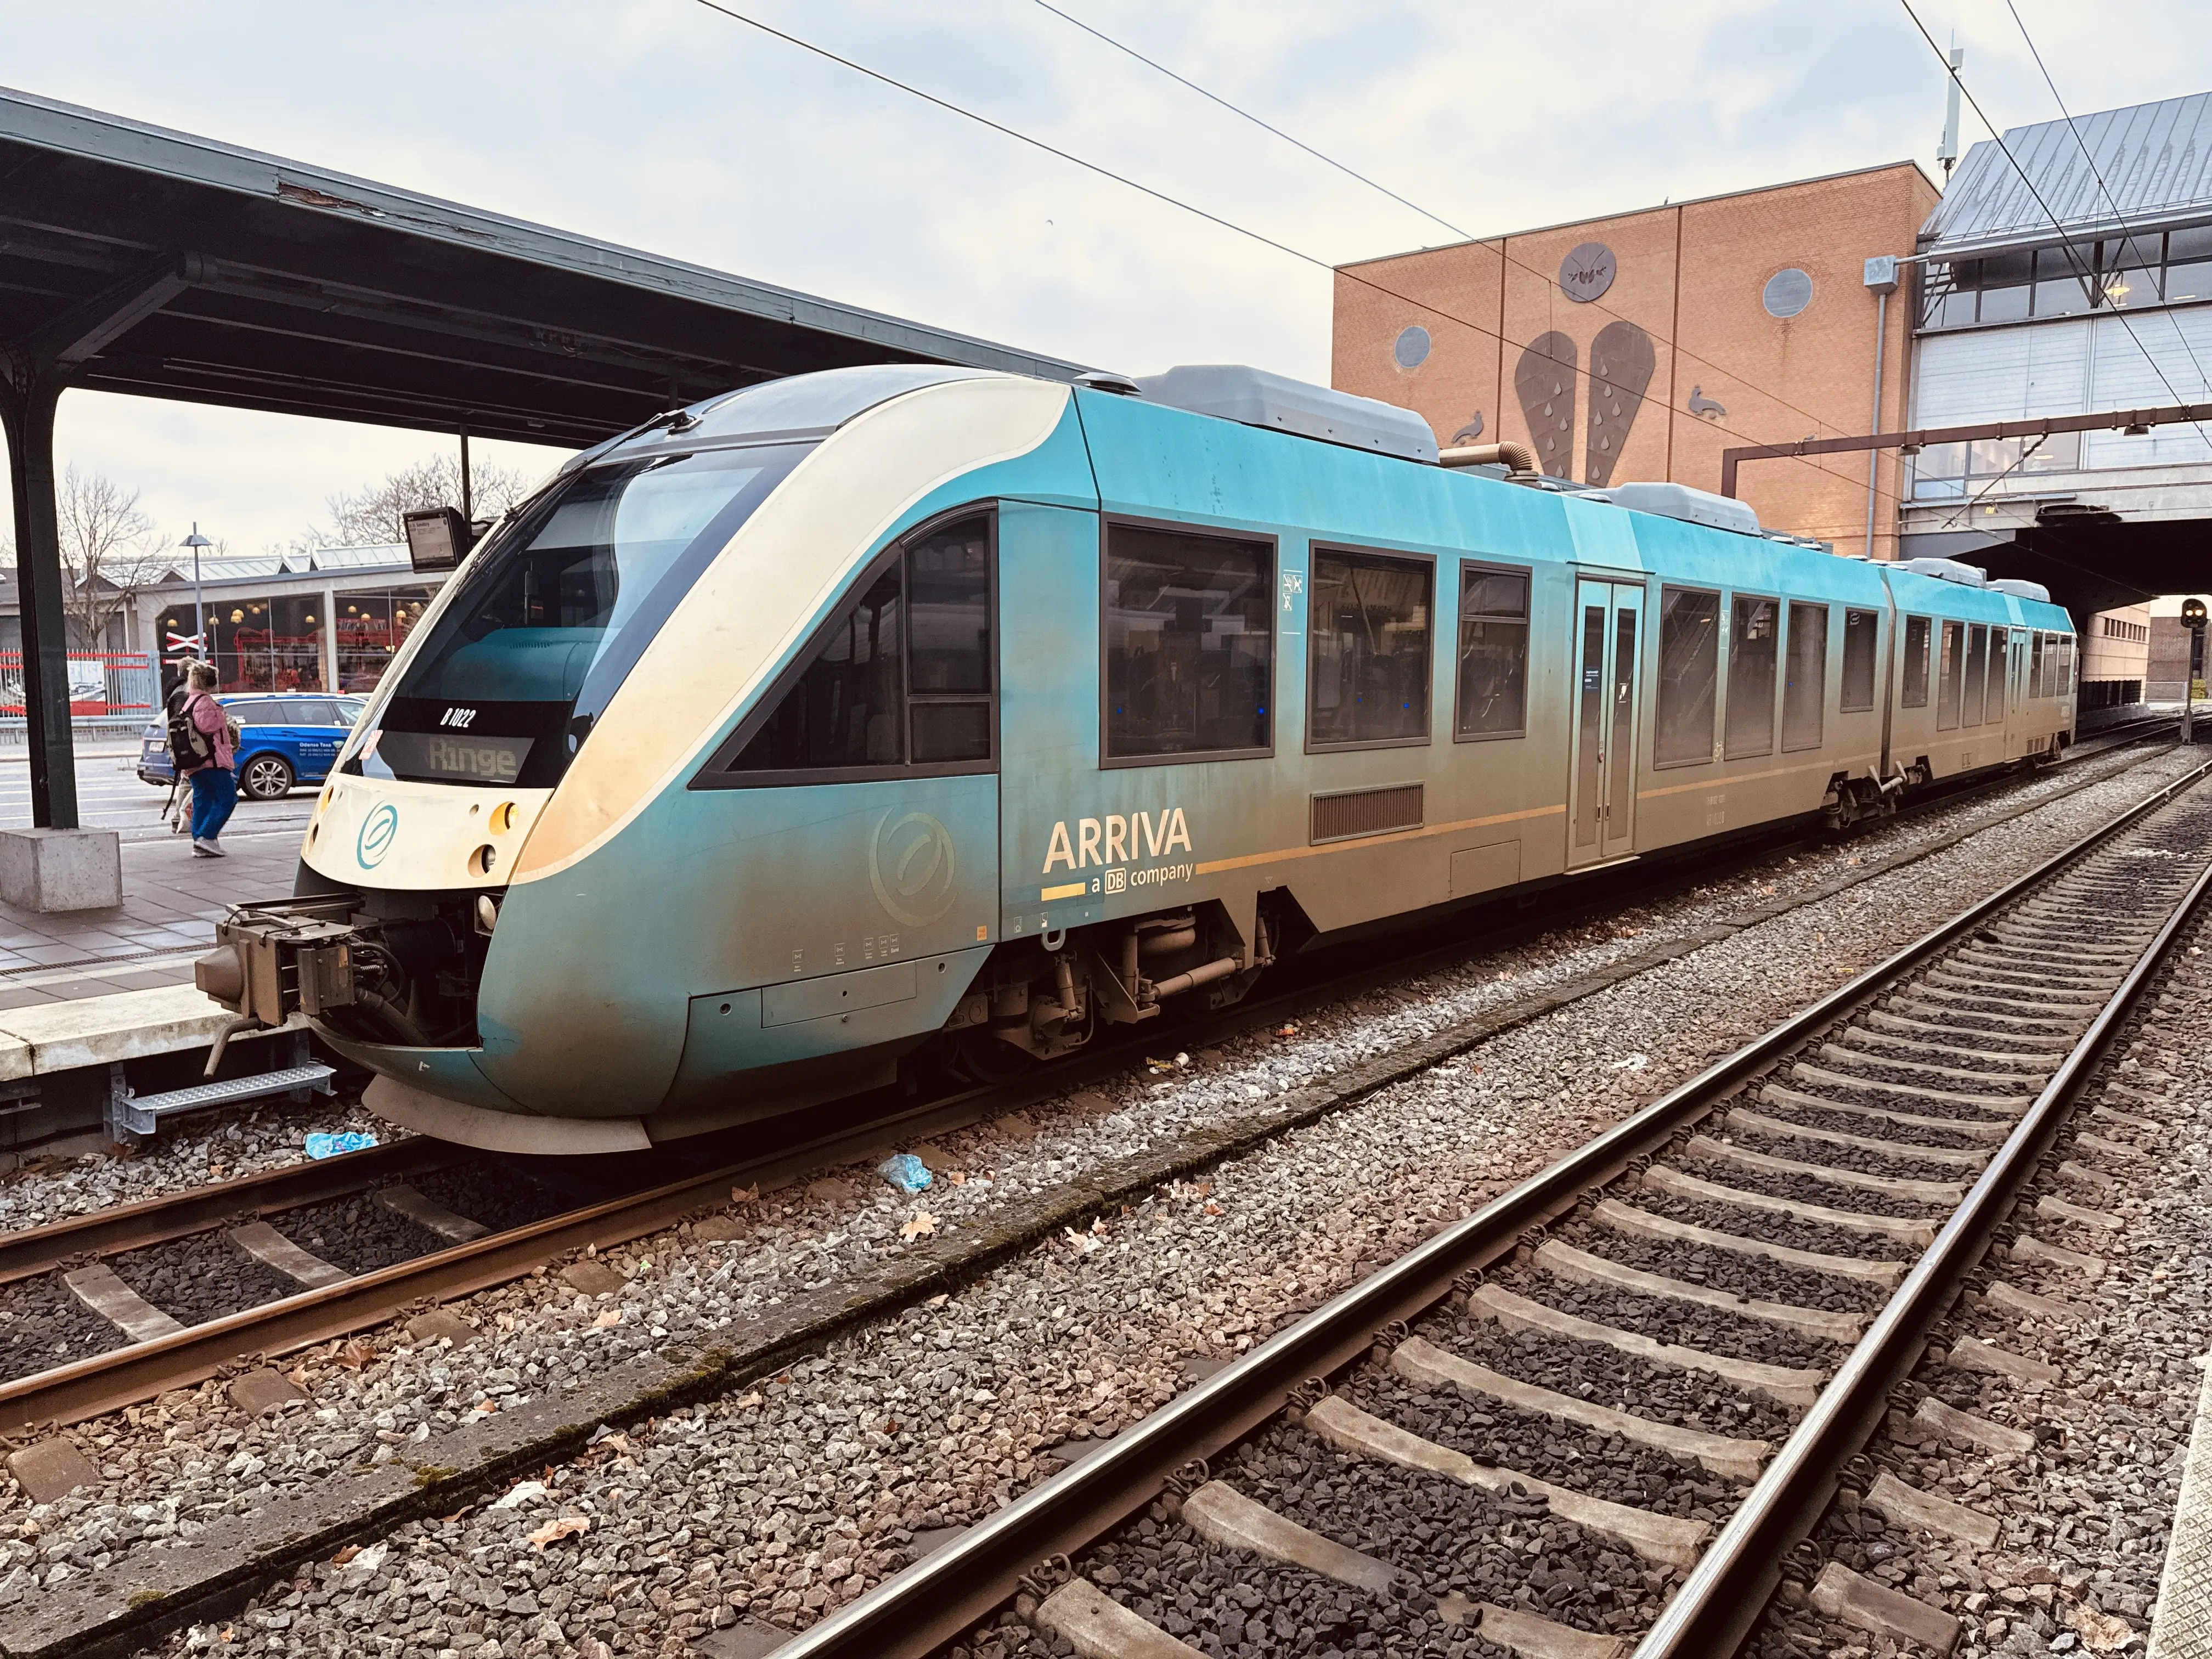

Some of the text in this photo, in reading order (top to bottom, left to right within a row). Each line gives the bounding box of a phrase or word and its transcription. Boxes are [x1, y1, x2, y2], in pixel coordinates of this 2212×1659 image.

[440, 708, 476, 728] B 1022
[429, 737, 516, 776] Ringe
[1042, 807, 1192, 873] ARRIVA
[1091, 863, 1193, 893] a DB company
